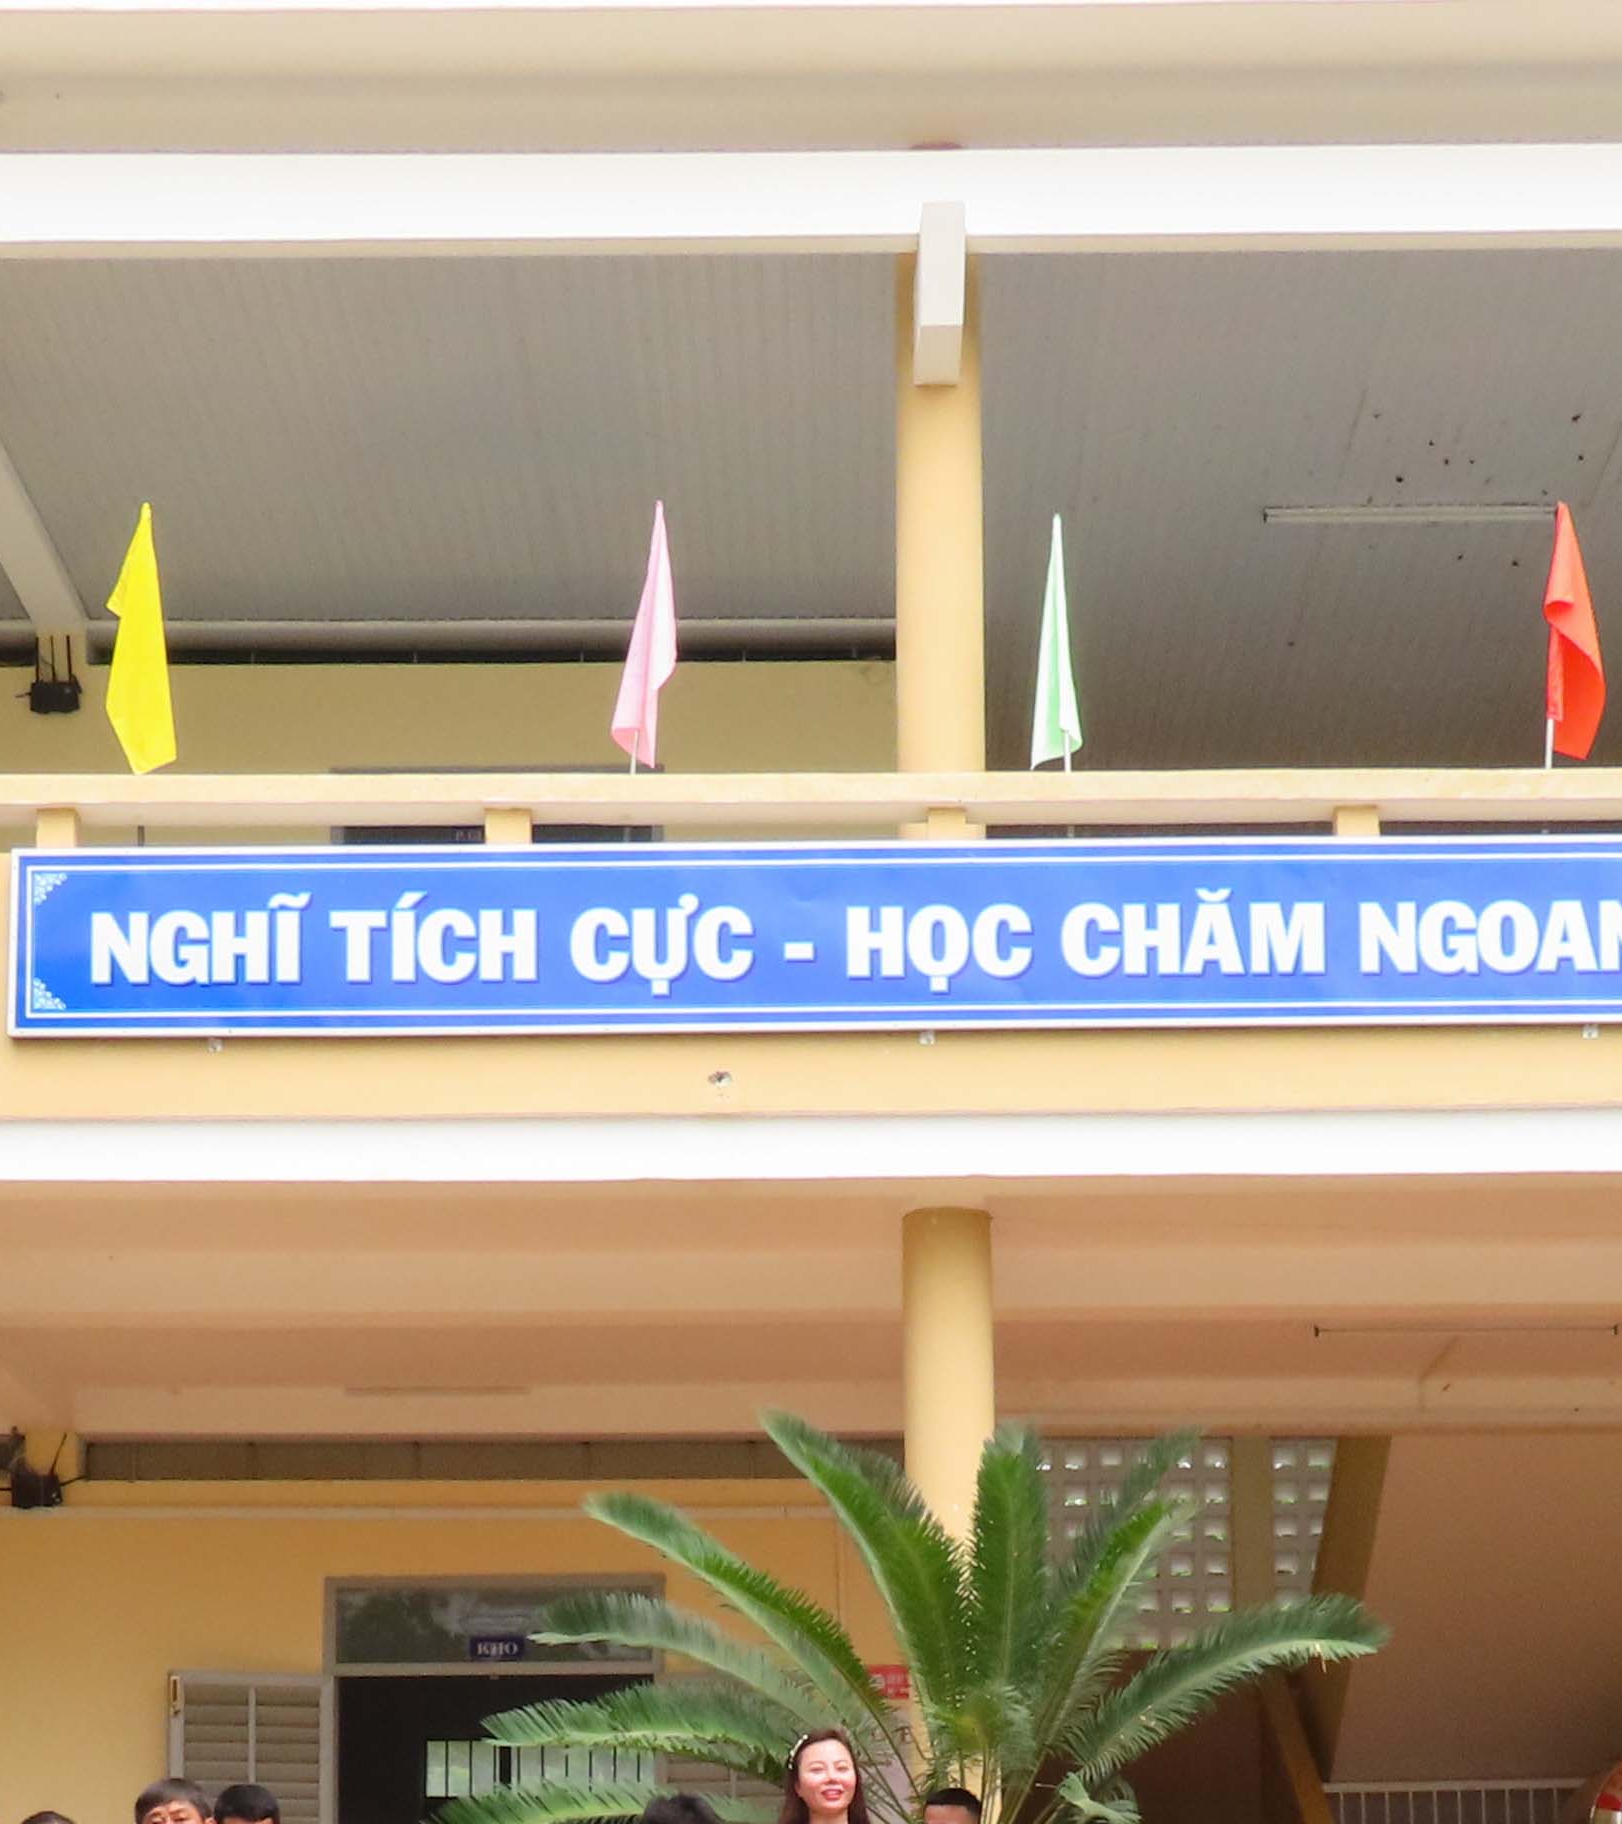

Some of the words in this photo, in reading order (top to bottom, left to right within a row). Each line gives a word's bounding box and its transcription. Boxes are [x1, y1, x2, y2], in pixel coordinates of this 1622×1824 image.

[90, 891, 312, 986] NGHĨ
[330, 890, 539, 983] TÍCH
[570, 893, 754, 996] CỰC
[783, 941, 815, 961] -
[846, 903, 1034, 993] HỌC
[1061, 887, 1326, 977] CHĂM
